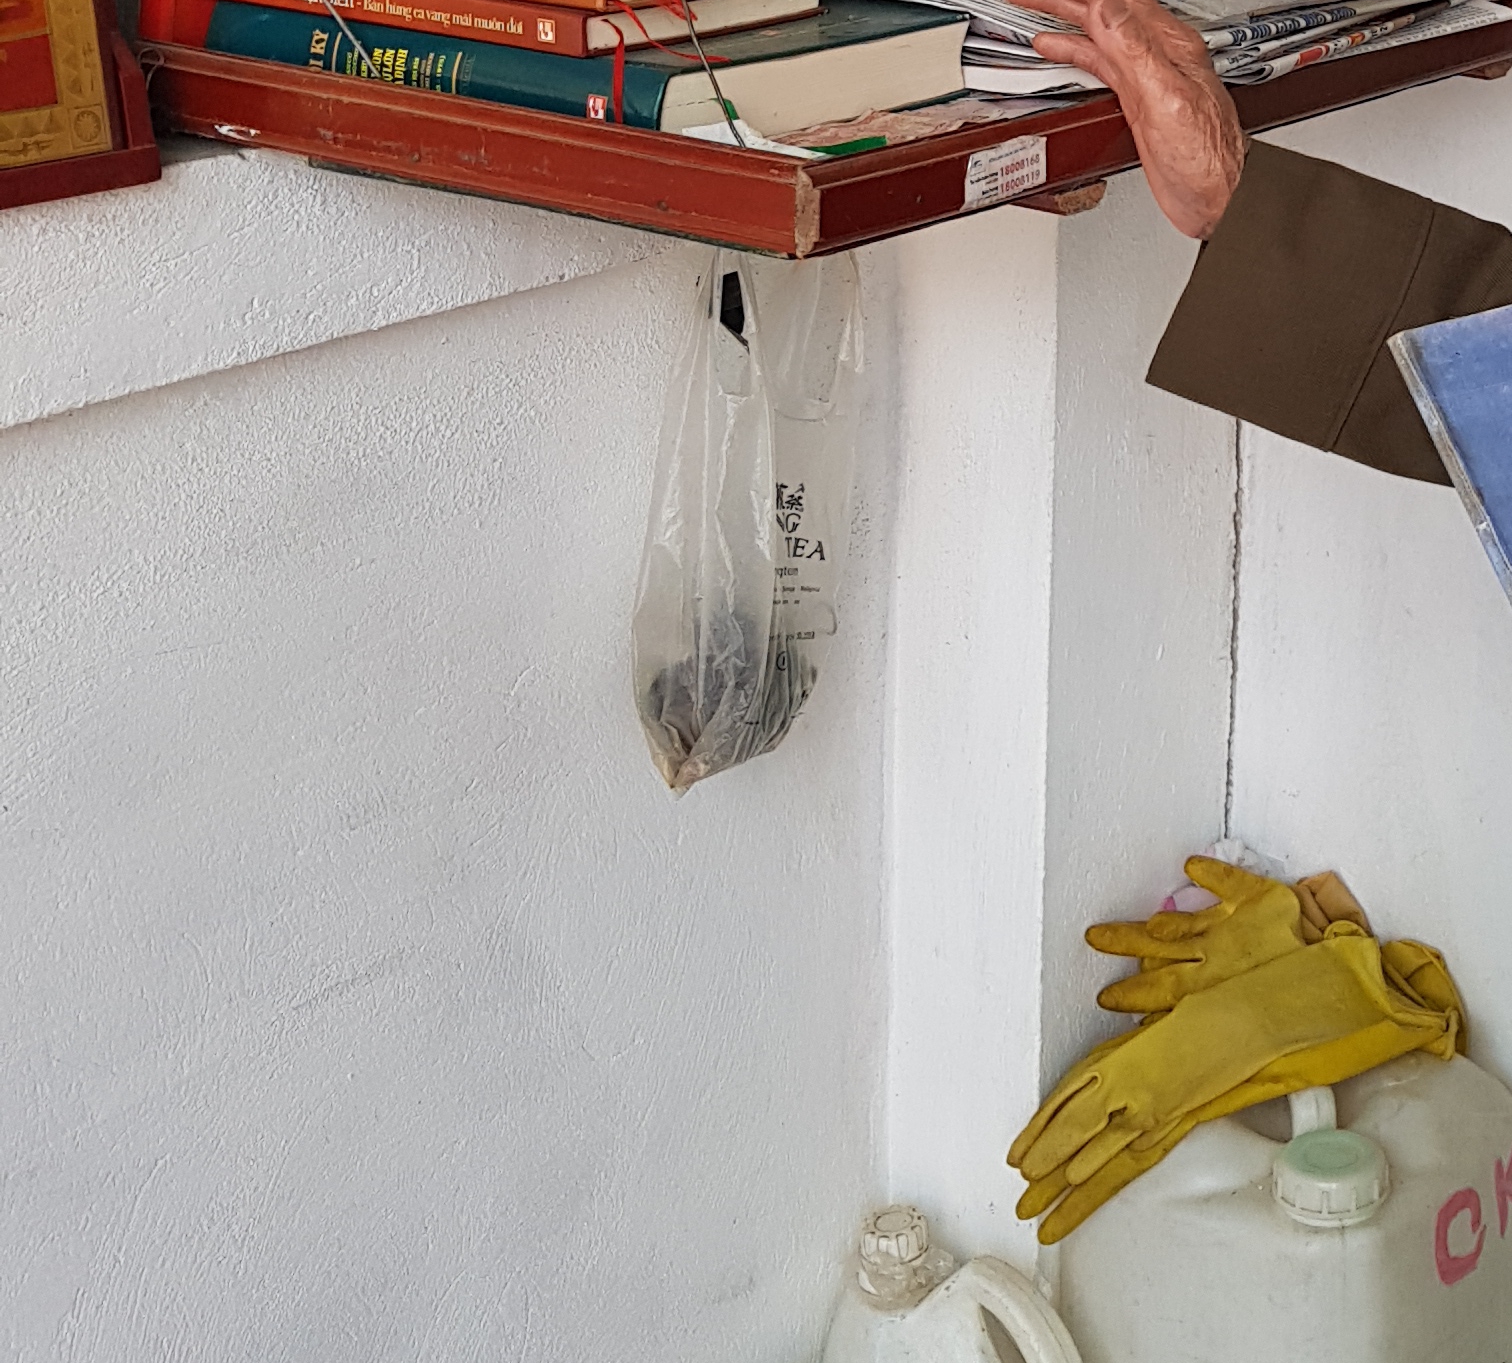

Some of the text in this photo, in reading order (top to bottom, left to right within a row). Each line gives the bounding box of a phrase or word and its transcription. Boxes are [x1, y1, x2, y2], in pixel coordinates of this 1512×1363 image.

[413, 9, 425, 20] ca
[425, 11, 450, 28] vang
[776, 512, 801, 534] NG
[785, 537, 825, 561] TEA
